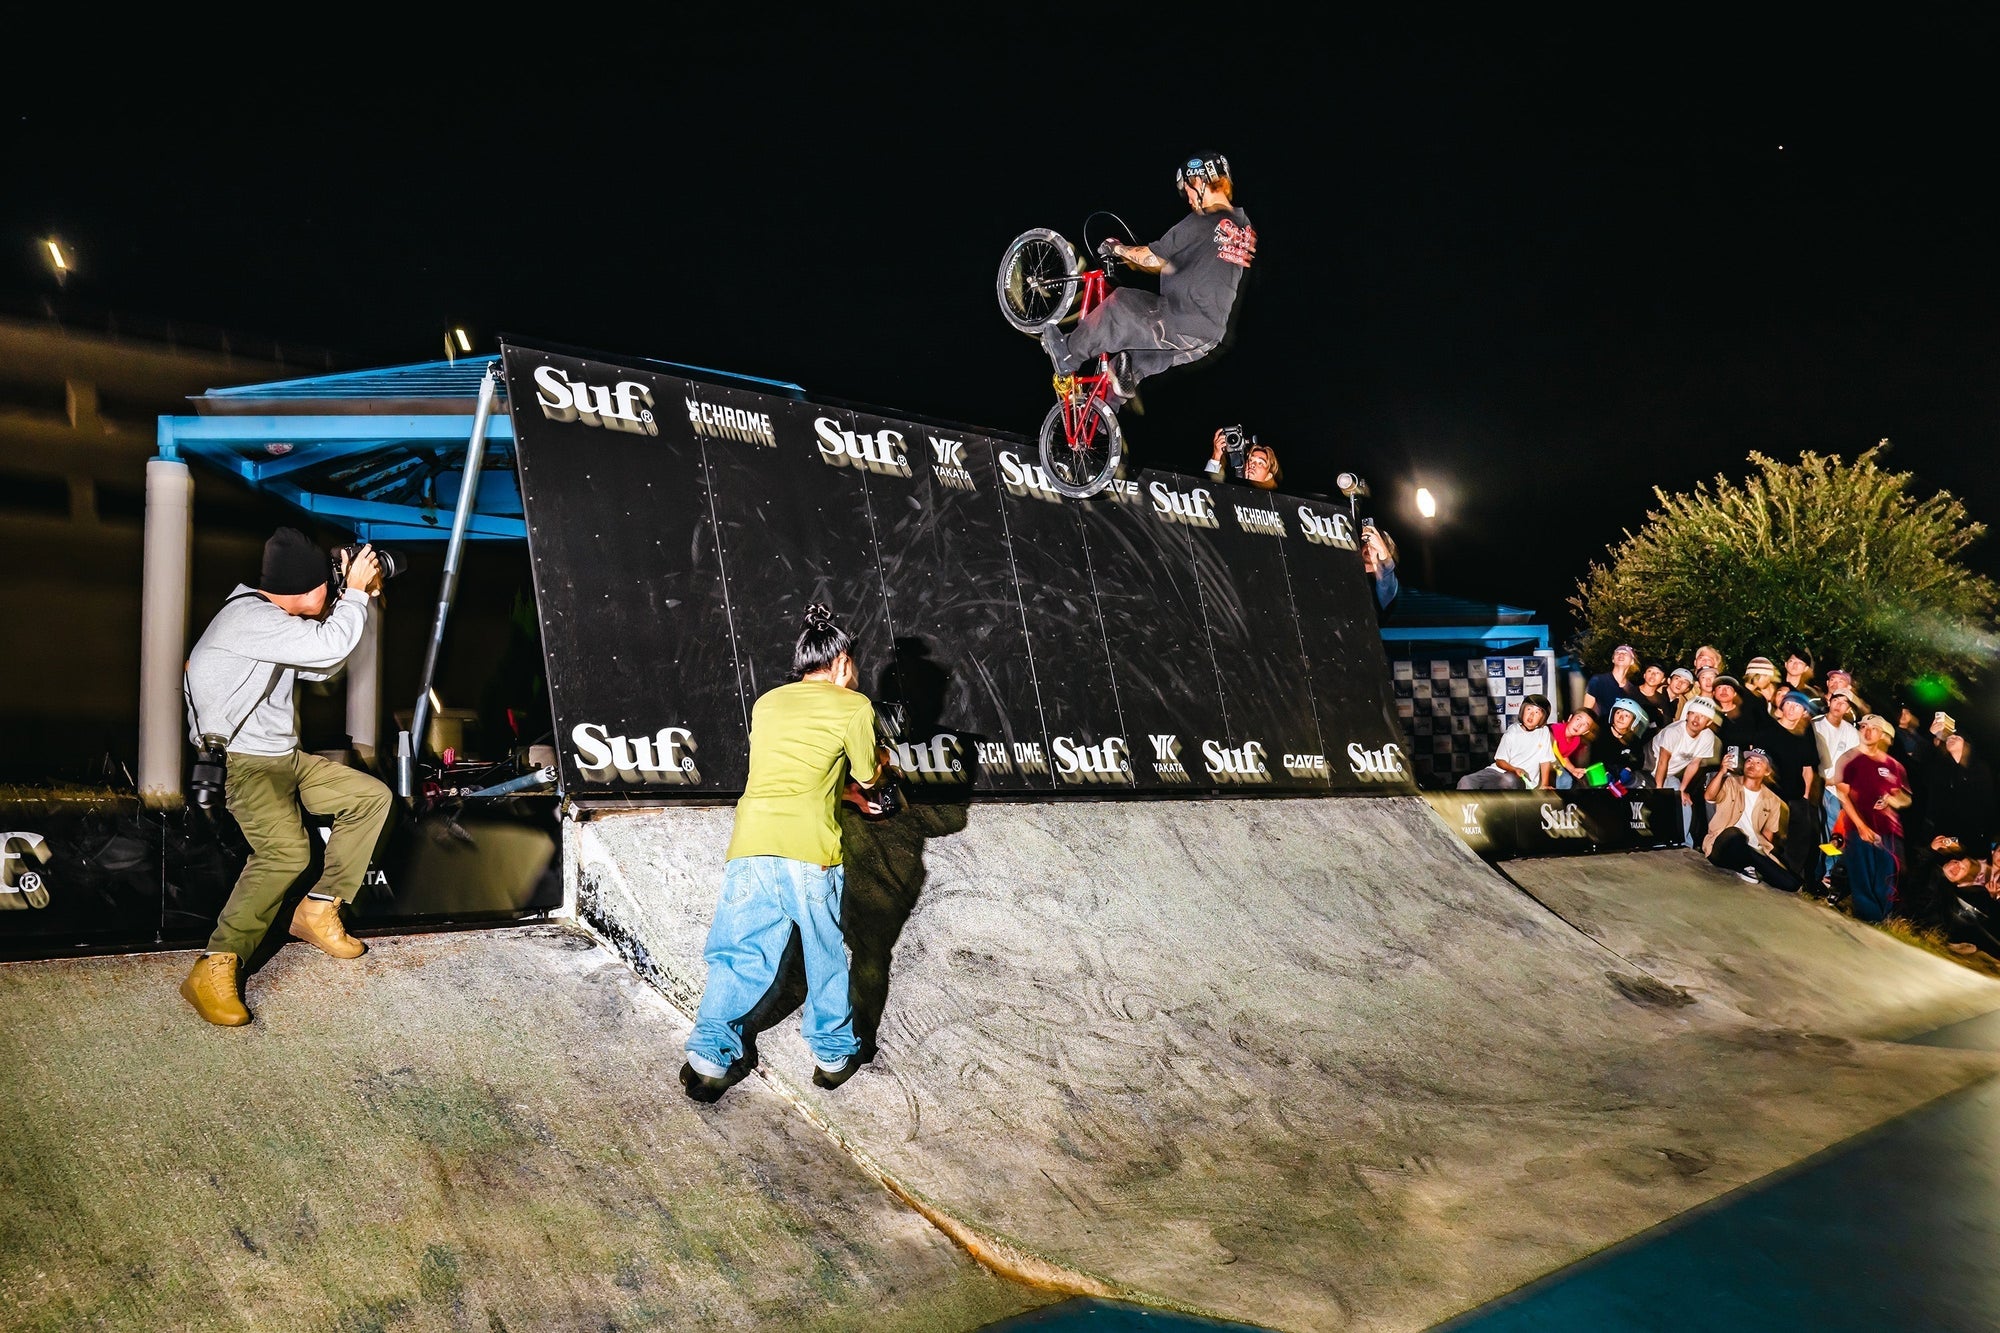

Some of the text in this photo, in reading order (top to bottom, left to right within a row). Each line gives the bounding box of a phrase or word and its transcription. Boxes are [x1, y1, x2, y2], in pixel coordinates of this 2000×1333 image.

[701, 402, 772, 435] CHROME
[931, 464, 971, 480] YAKATA
[1243, 507, 1282, 529] CHROME
[1152, 762, 1185, 773] YAKATA
[1283, 754, 1324, 769] CAVE
